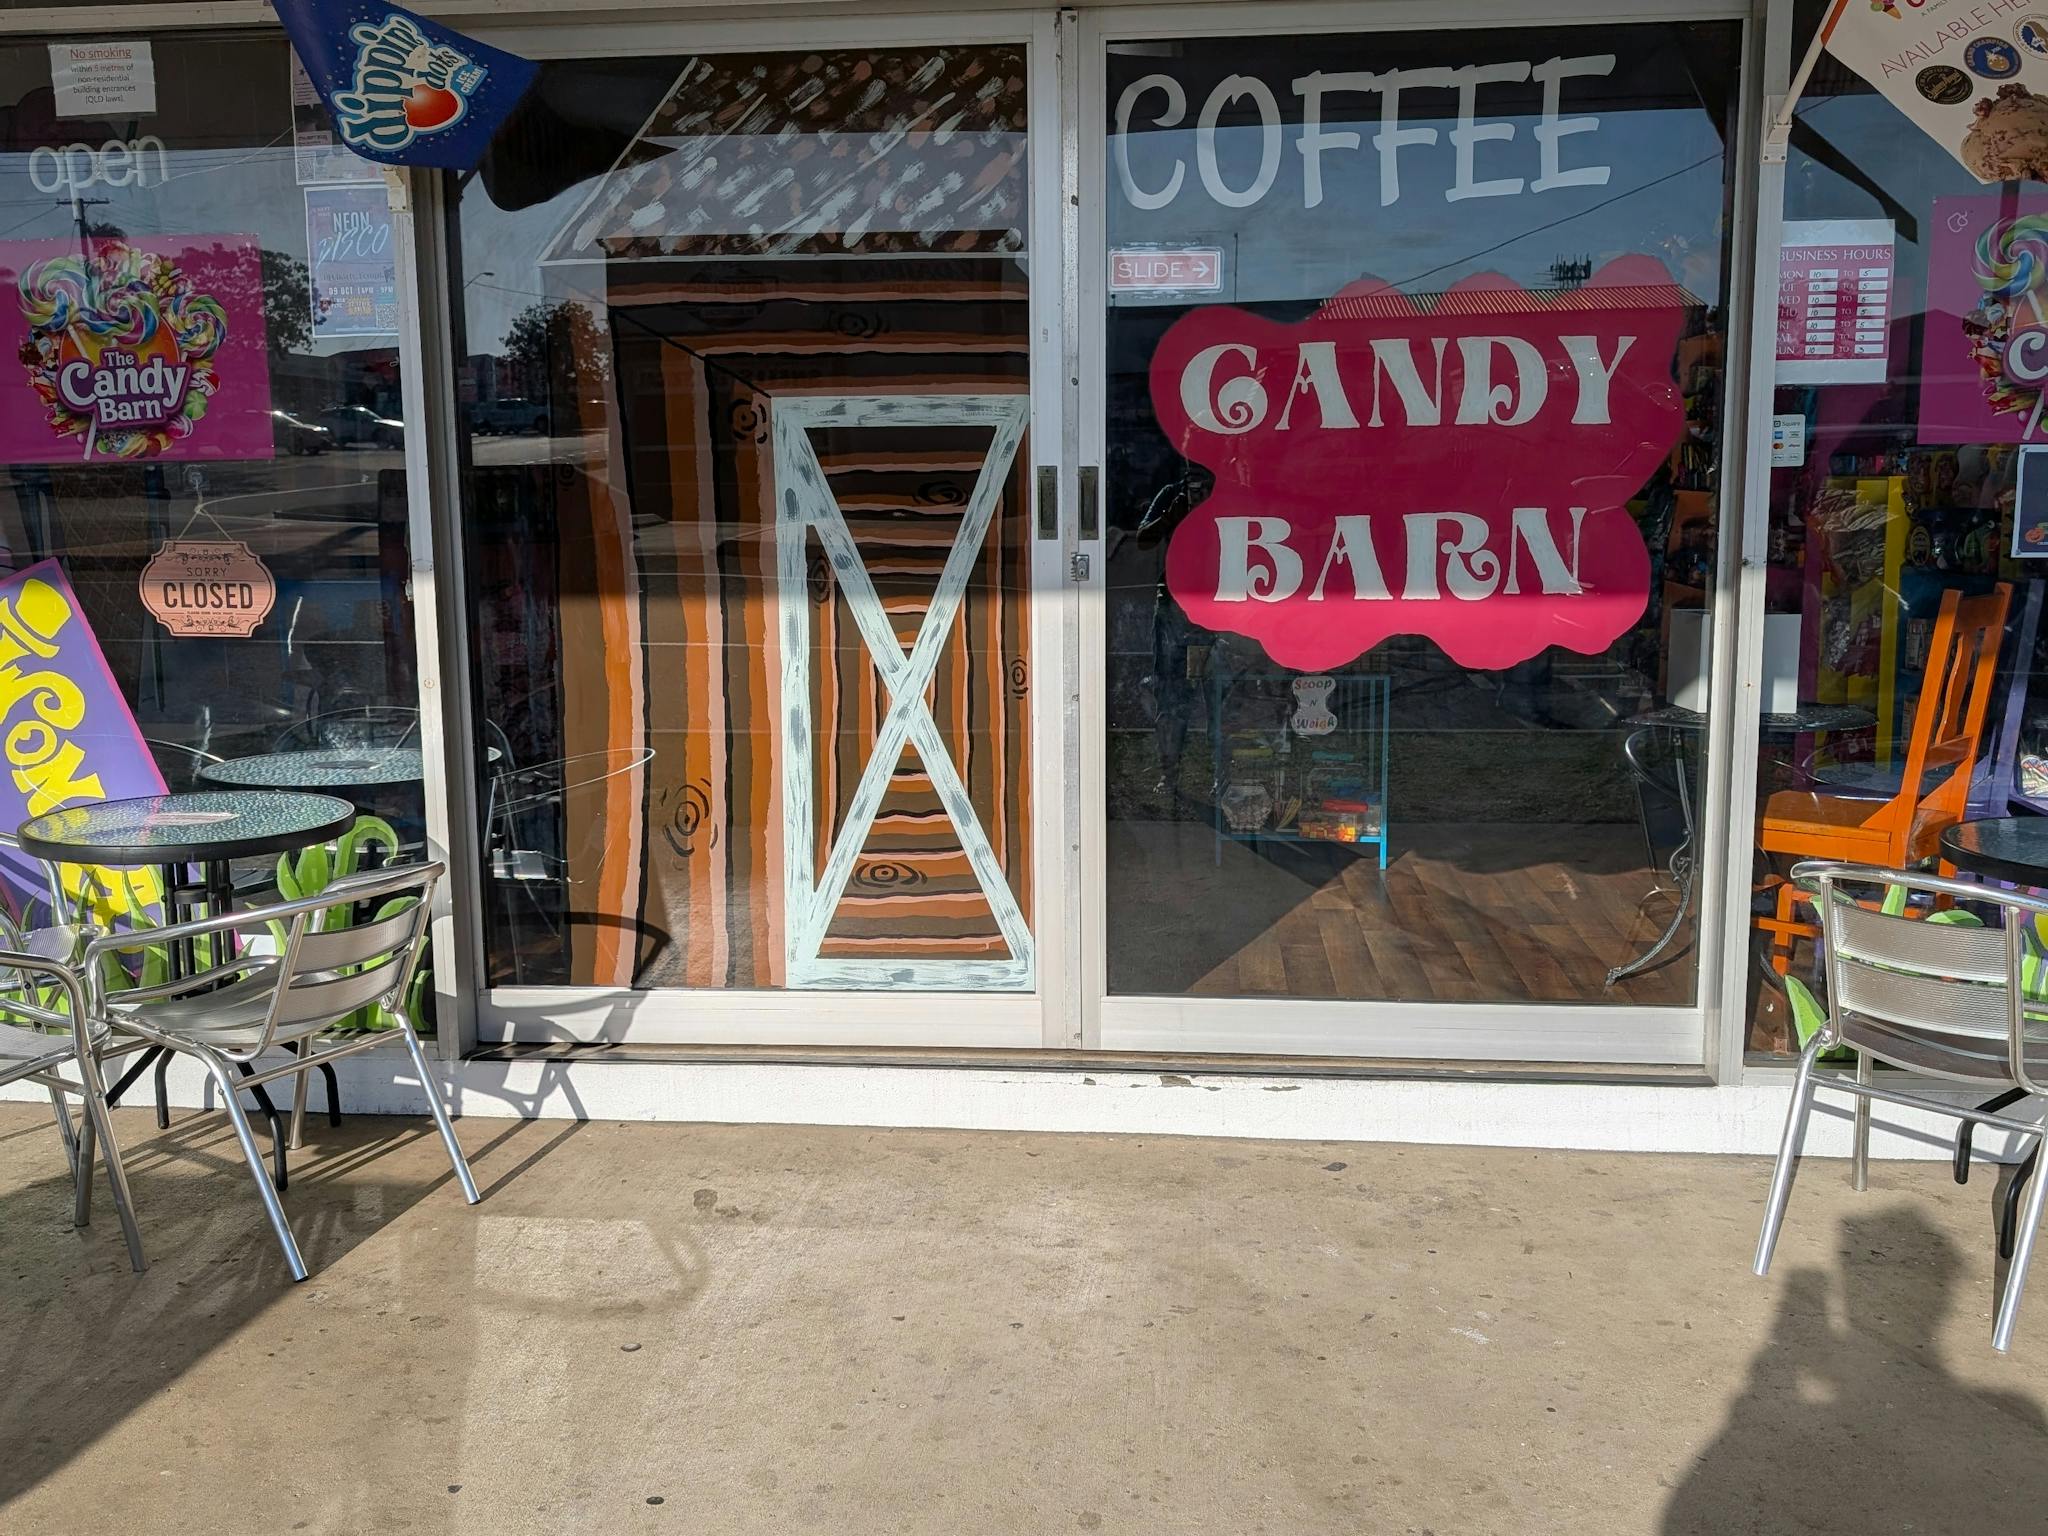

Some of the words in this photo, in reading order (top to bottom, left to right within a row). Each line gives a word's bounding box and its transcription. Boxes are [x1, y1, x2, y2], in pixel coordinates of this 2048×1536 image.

[1881, 7, 1993, 79] AVAILABLE
[70, 49, 86, 59] No
[88, 48, 132, 60] smoking
[71, 64, 93, 72] within
[126, 63, 134, 71] of
[416, 50, 460, 90] dots
[77, 75, 130, 83] non-residential
[456, 70, 471, 84] ICE
[73, 86, 101, 94] building
[1114, 54, 1616, 210] COFFEE
[29, 135, 169, 220] open
[333, 211, 370, 233] NEON
[316, 223, 389, 270] DISCO
[1780, 249, 1838, 261] BUSINESS
[1843, 248, 1891, 260] HOURS
[1118, 262, 1184, 278] SLIDE
[1778, 307, 1798, 317] HU
[1776, 346, 1795, 354] UN
[104, 352, 135, 367] The
[61, 358, 187, 408] Candy
[1179, 335, 1637, 436] CANDY
[97, 398, 162, 423] Barn
[1213, 507, 1588, 602] BARN
[186, 567, 228, 577] SORRY
[163, 582, 253, 609] CLOSED
[1295, 679, 1333, 690] Scoop
